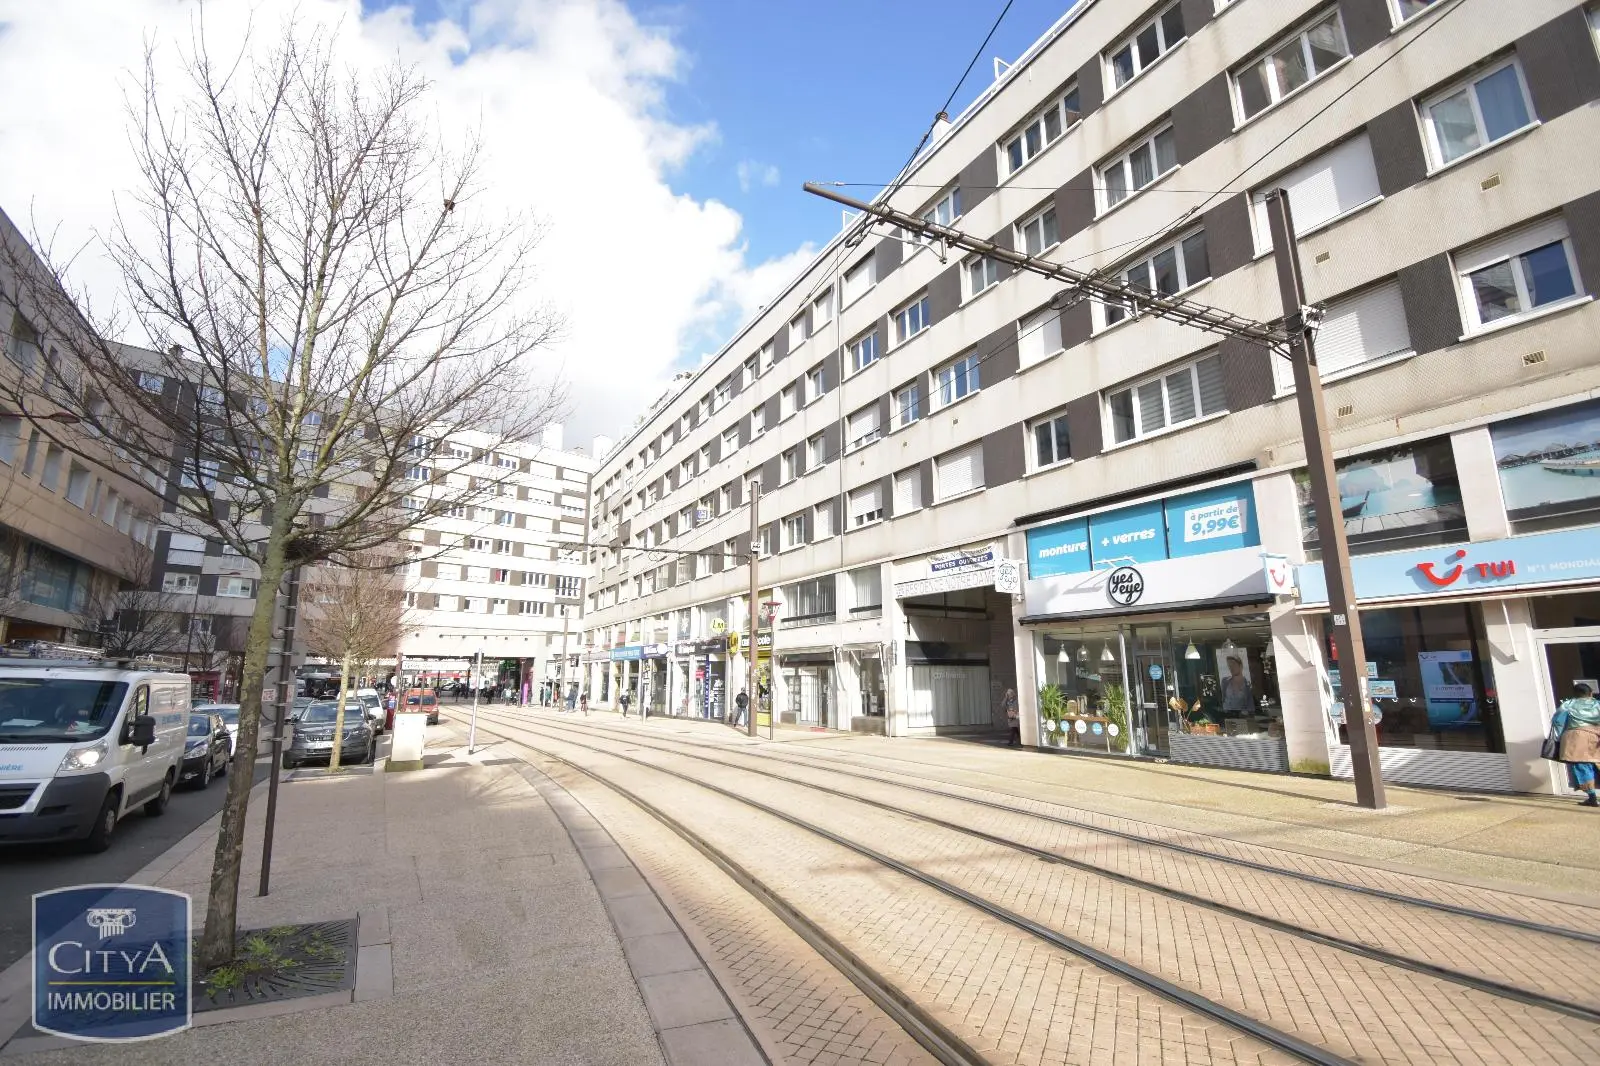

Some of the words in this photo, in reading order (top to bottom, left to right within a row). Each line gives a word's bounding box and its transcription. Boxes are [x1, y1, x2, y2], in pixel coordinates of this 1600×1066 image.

[1198, 507, 1225, 521] partir
[1226, 505, 1238, 515] de
[1191, 515, 1239, 535] 9,99€
[1113, 528, 1156, 544] verres
[1039, 542, 1088, 559] monture
[934, 561, 956, 571] PORTES
[1475, 560, 1516, 578] TUI
[1112, 573, 1134, 594] yes
[1119, 582, 1143, 603] eye
